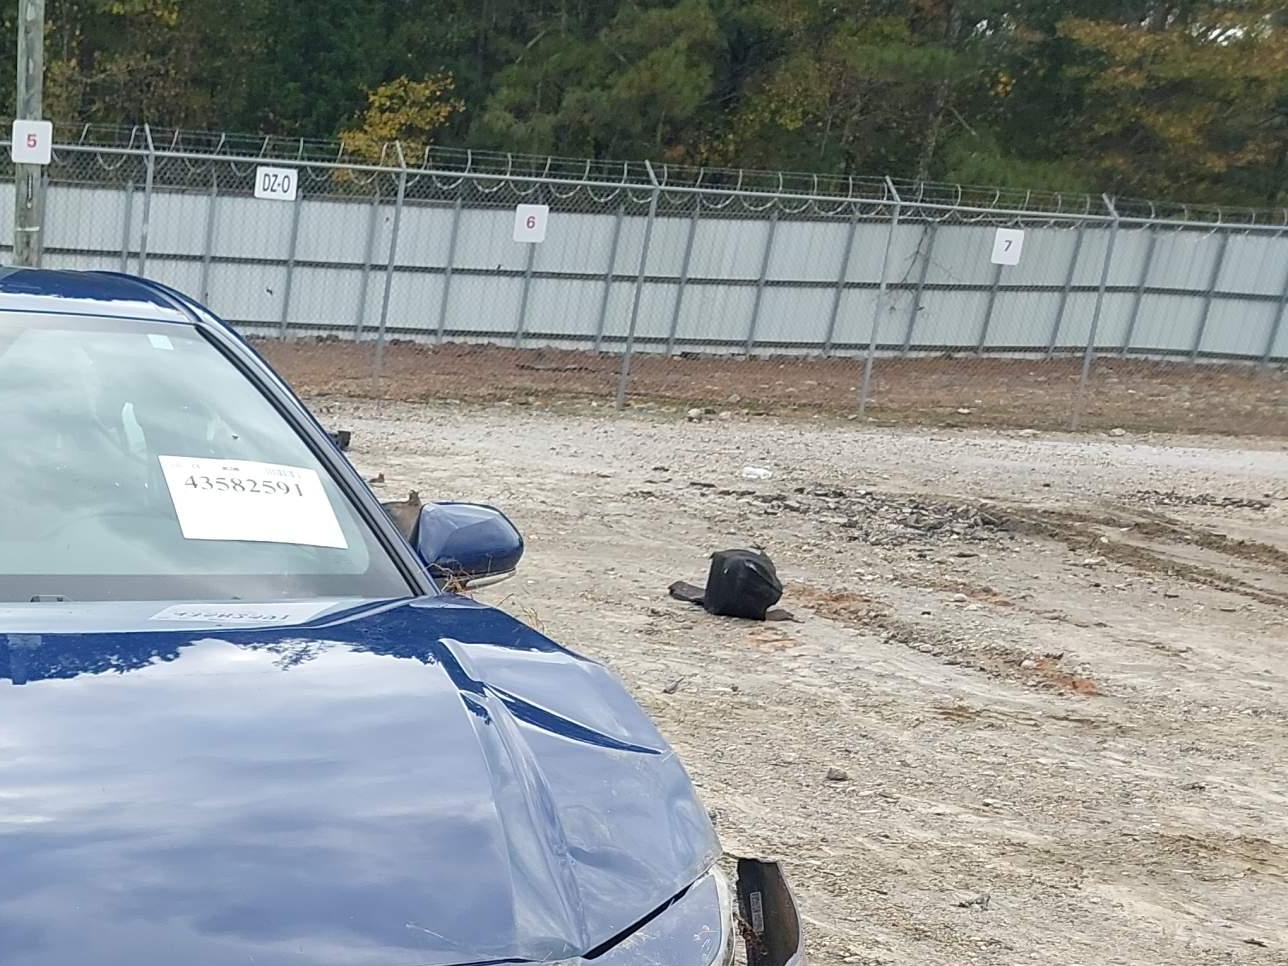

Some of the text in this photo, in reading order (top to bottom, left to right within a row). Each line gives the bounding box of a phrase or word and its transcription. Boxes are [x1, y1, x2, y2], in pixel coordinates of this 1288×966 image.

[26, 133, 38, 149] 5
[526, 215, 536, 229] 6
[1004, 239, 1013, 252] 7
[183, 474, 304, 498] 43582591
